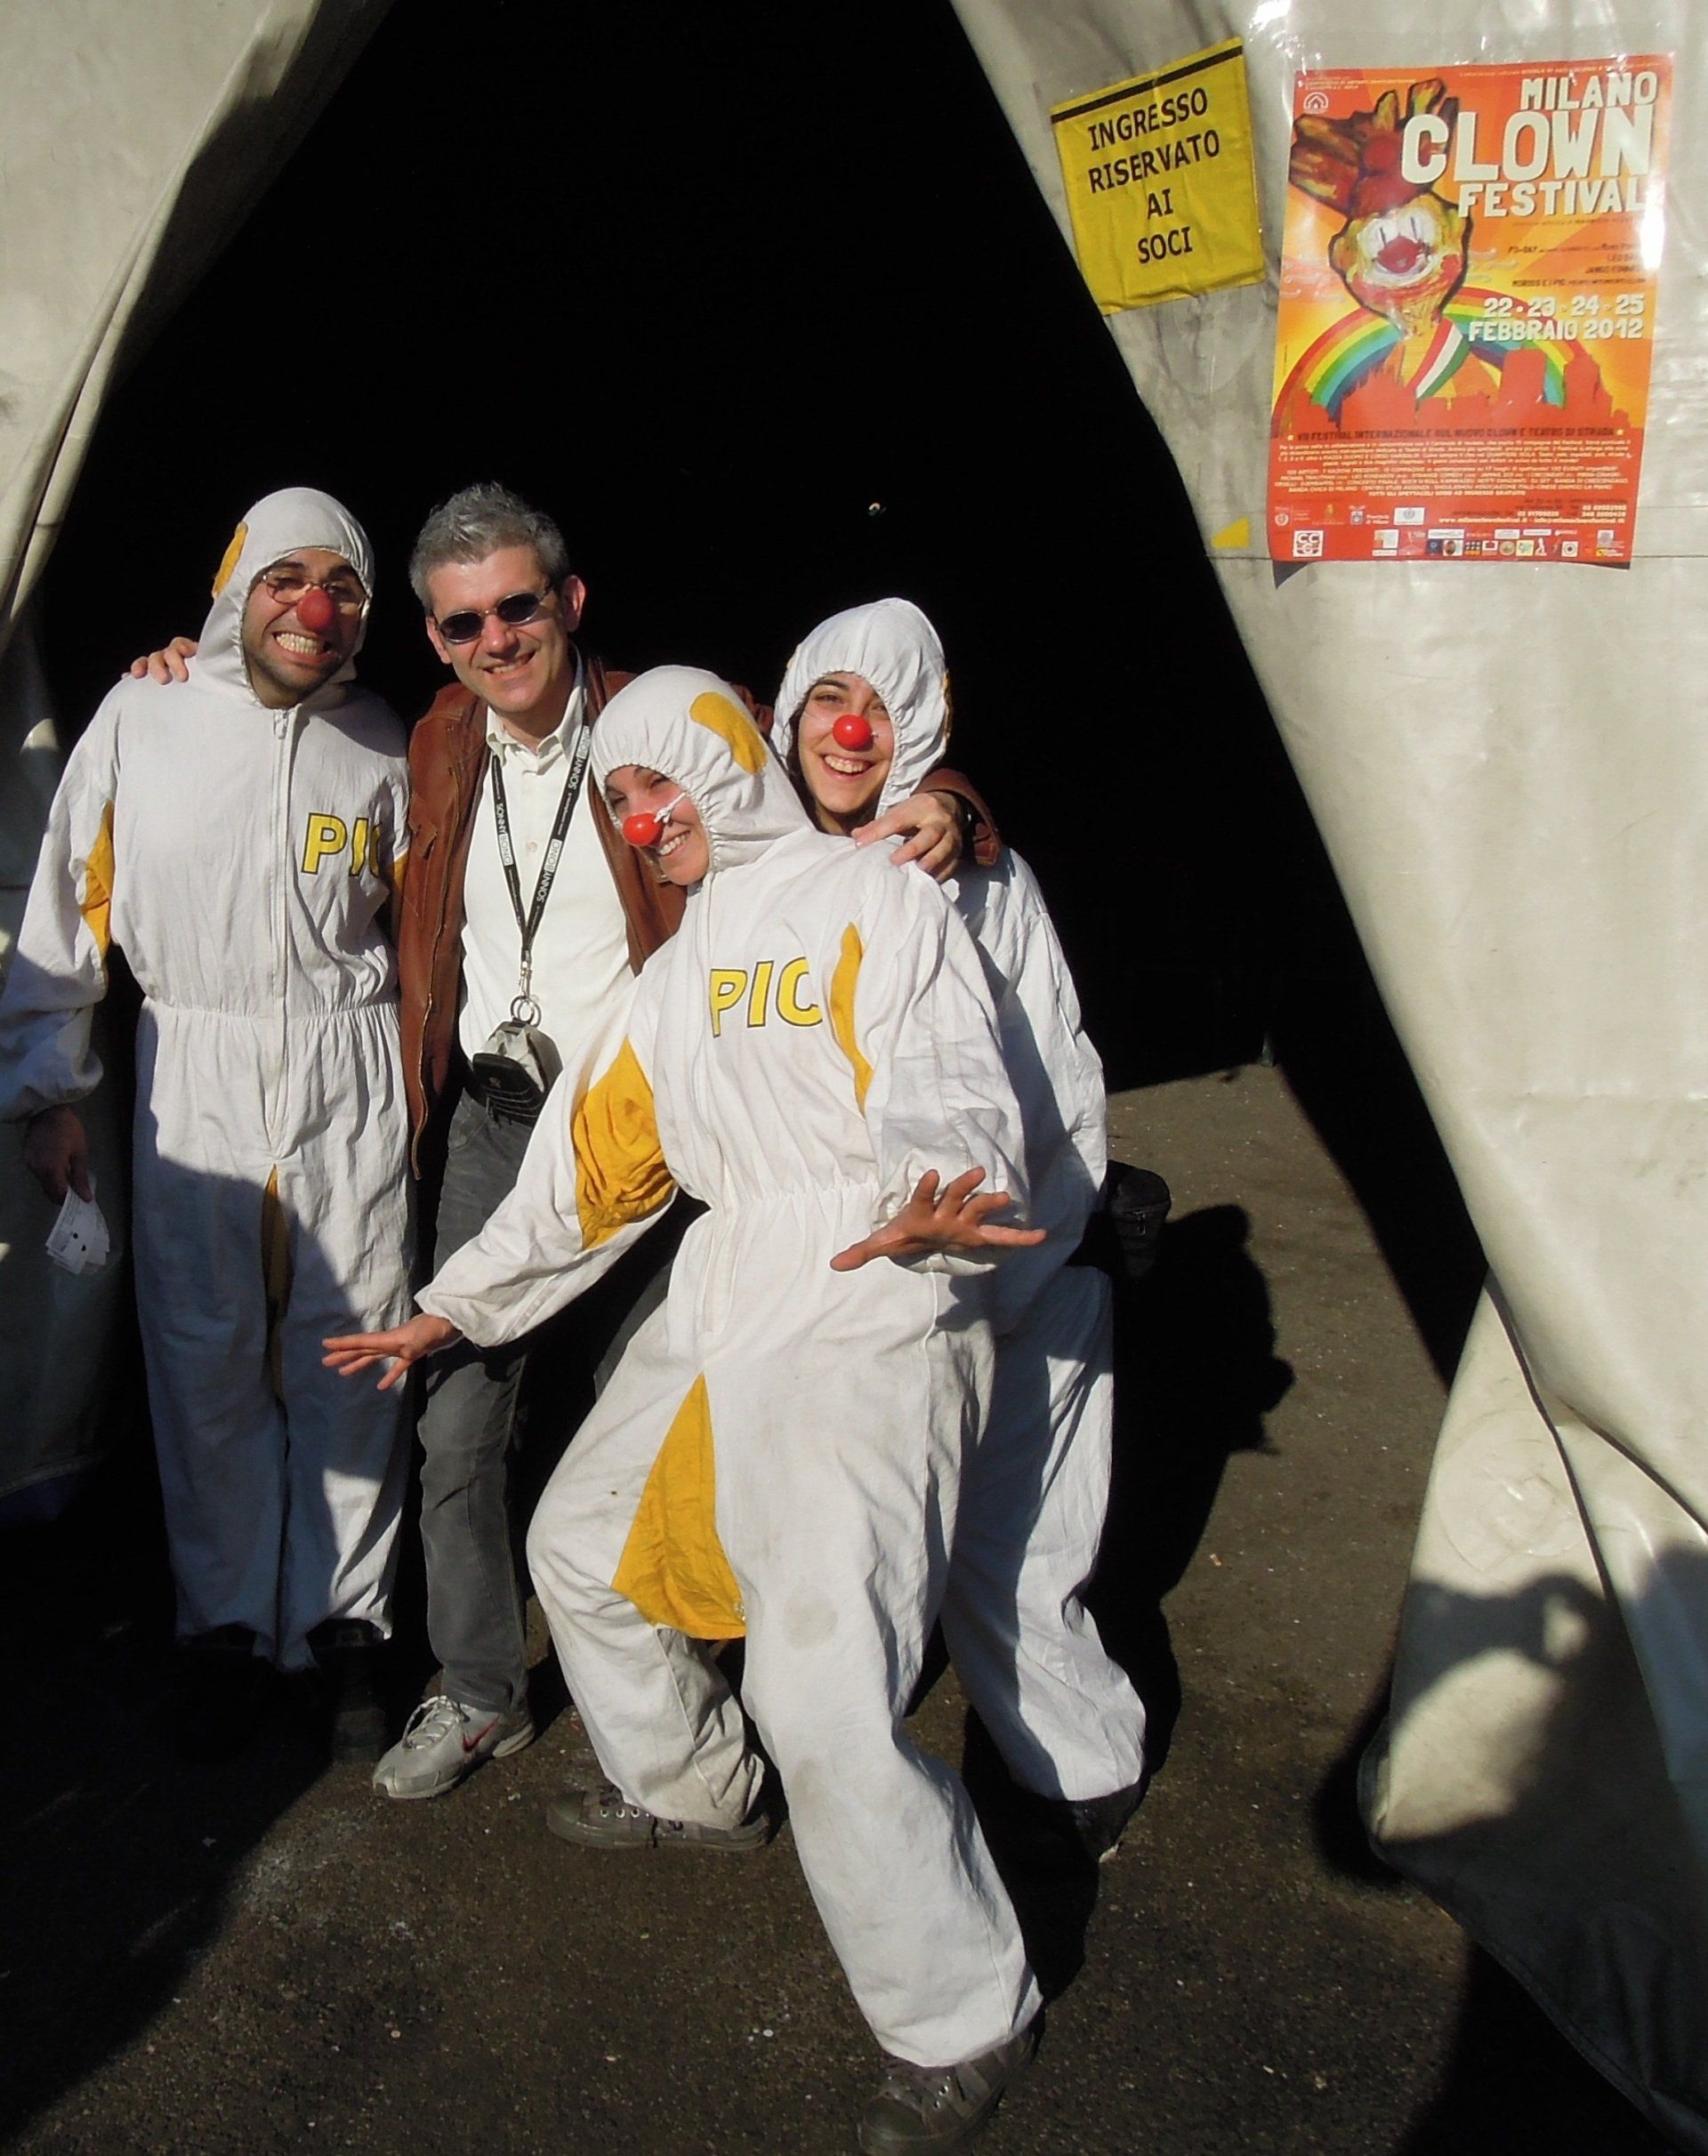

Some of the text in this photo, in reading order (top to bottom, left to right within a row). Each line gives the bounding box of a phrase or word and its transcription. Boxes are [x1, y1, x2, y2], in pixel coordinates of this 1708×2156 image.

[1520, 71, 1658, 111] MILANO
[1087, 87, 1209, 151] INGRESSO
[1087, 129, 1221, 194] RISERVATO
[1400, 104, 1654, 184] CLOWN
[1147, 188, 1174, 221] AI
[1457, 178, 1647, 218] FESTIVAL
[1137, 226, 1193, 265] SOCI
[1483, 294, 1645, 318] 22 23 24 25
[1468, 318, 1644, 342] FEBBRAIO 2012
[708, 956, 824, 1038] PIC
